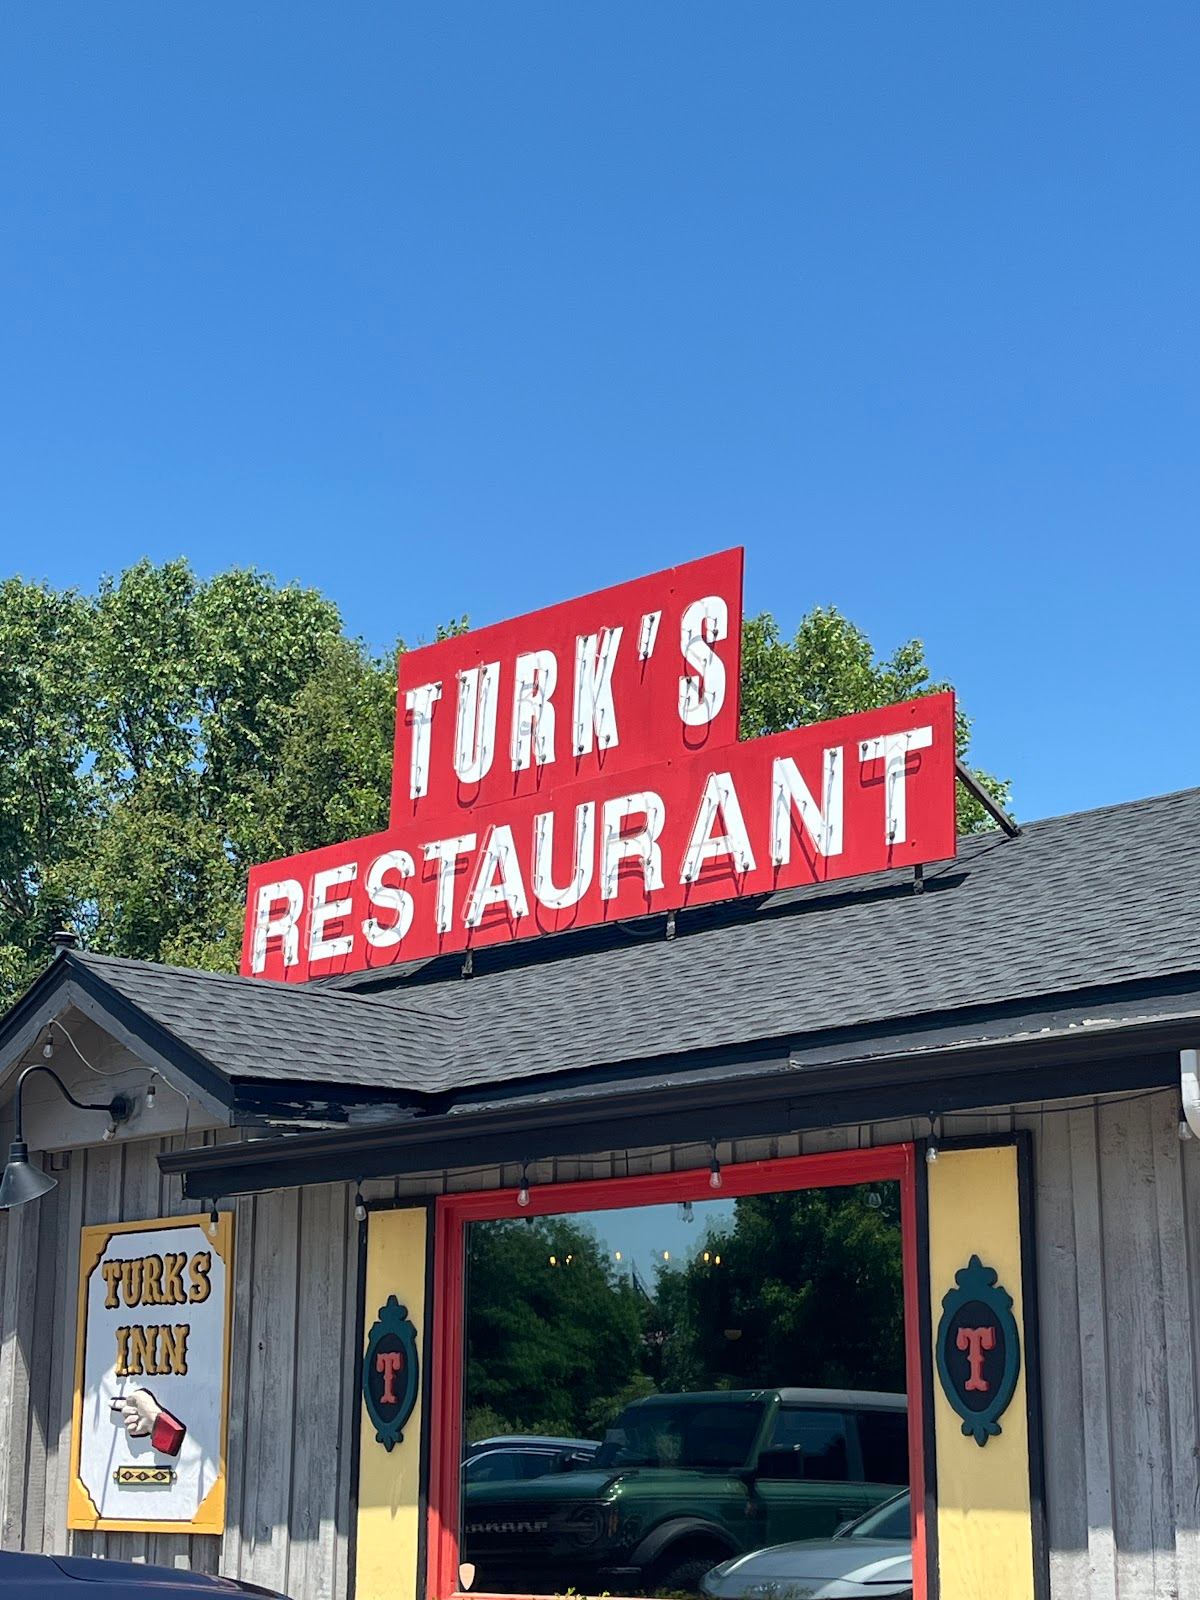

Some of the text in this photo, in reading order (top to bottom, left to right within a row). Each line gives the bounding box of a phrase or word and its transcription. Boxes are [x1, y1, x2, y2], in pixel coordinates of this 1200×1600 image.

[404, 595, 730, 800] TURK'S
[250, 726, 934, 974] RESTAURANT
[102, 1251, 211, 1309] TURKS
[115, 1324, 190, 1376] INN
[376, 1352, 403, 1404] T
[956, 1327, 997, 1391] T
